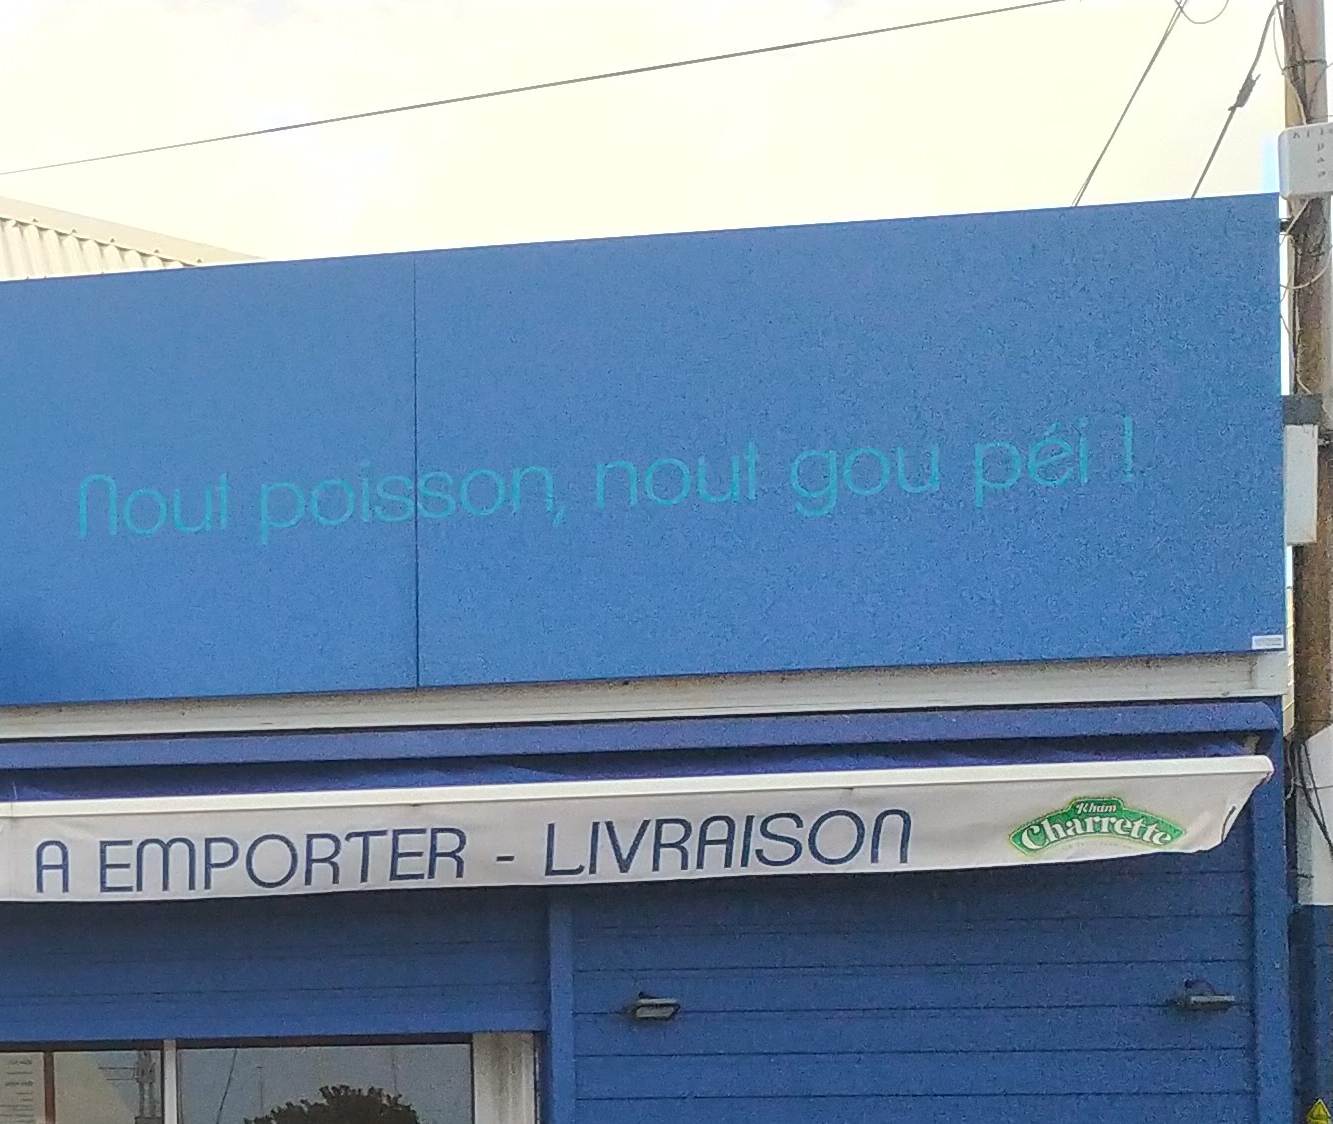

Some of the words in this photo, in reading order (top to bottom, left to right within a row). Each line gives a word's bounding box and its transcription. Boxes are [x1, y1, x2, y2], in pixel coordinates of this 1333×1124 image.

[77, 471, 229, 538] Nout
[259, 457, 567, 546] poisson,
[595, 440, 760, 511] nout
[789, 440, 940, 518] gou
[975, 416, 1090, 510] péi
[1121, 415, 1136, 486] !
[34, 839, 70, 894] A
[98, 826, 468, 894] EMPORTER
[544, 808, 913, 878] LIVRAISON
[1020, 815, 1173, 851] Charrette
